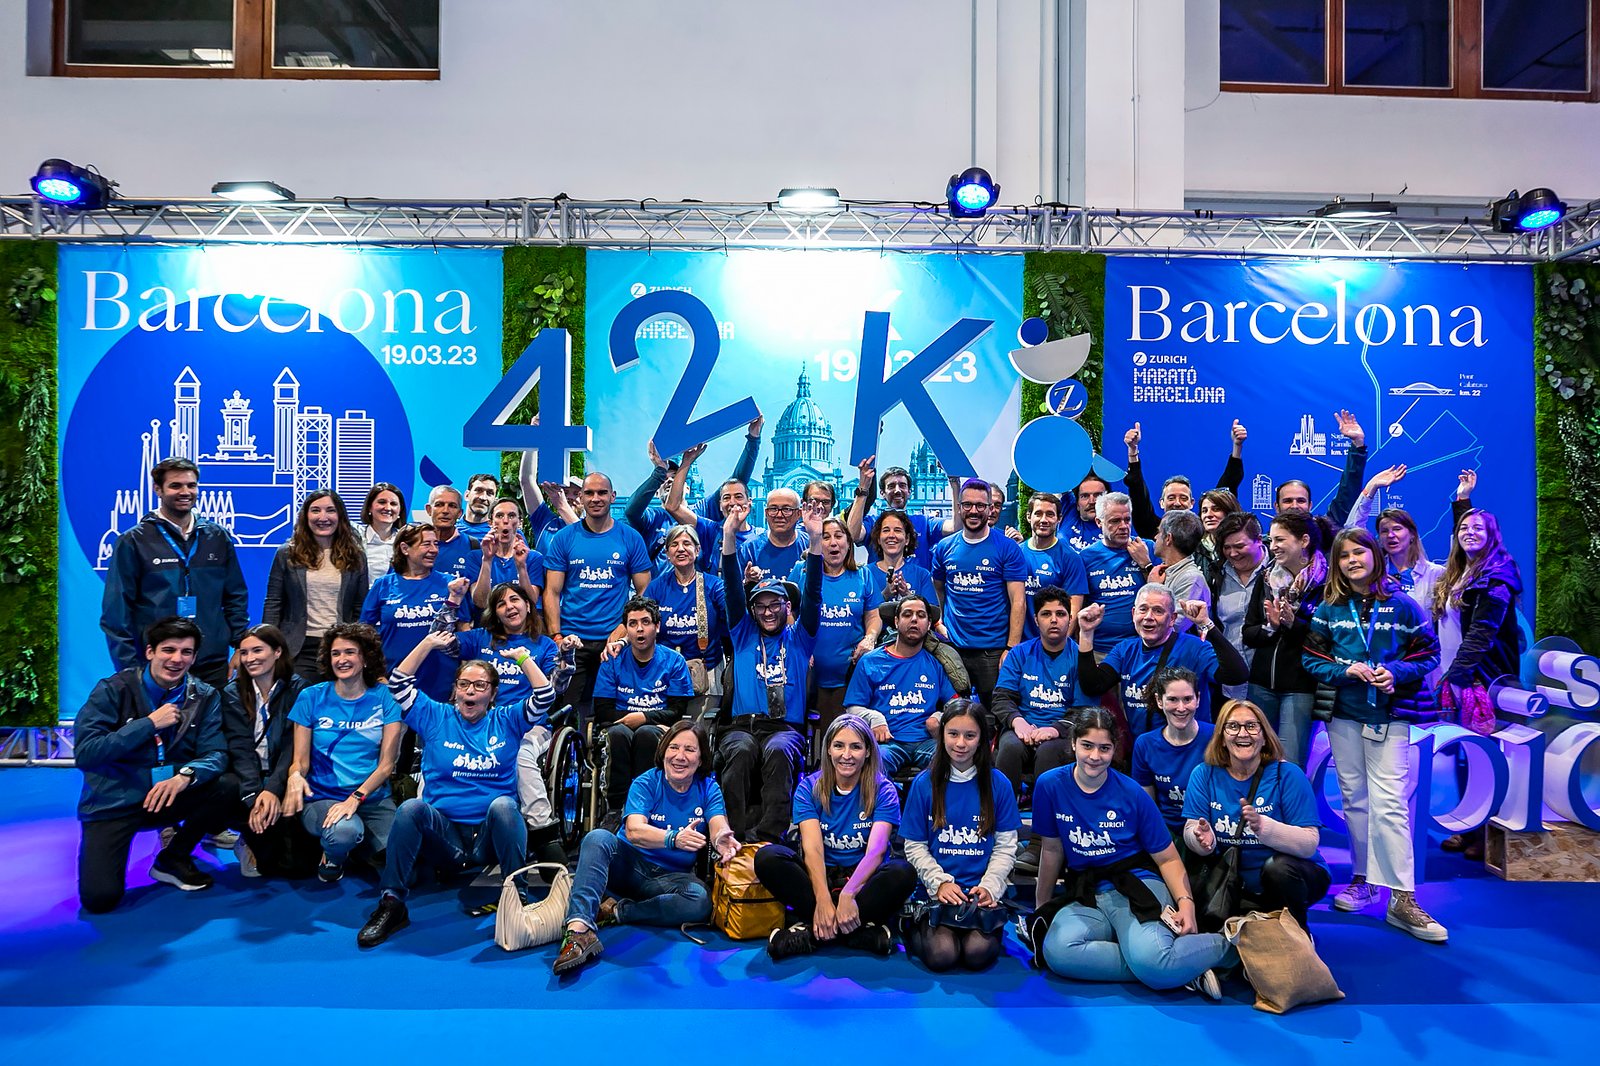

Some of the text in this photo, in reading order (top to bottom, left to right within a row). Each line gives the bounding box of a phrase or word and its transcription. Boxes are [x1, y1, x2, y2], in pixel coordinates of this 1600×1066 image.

[1127, 281, 1488, 348] Barcelona
[380, 344, 478, 366] 19.03.23
[1149, 355, 1187, 364] ZURICH
[1133, 365, 1197, 385] MARATÓ
[1133, 386, 1225, 404] BARCELONA
[853, 821, 873, 830] ZURIC
[1099, 821, 1124, 829] ZURICH
